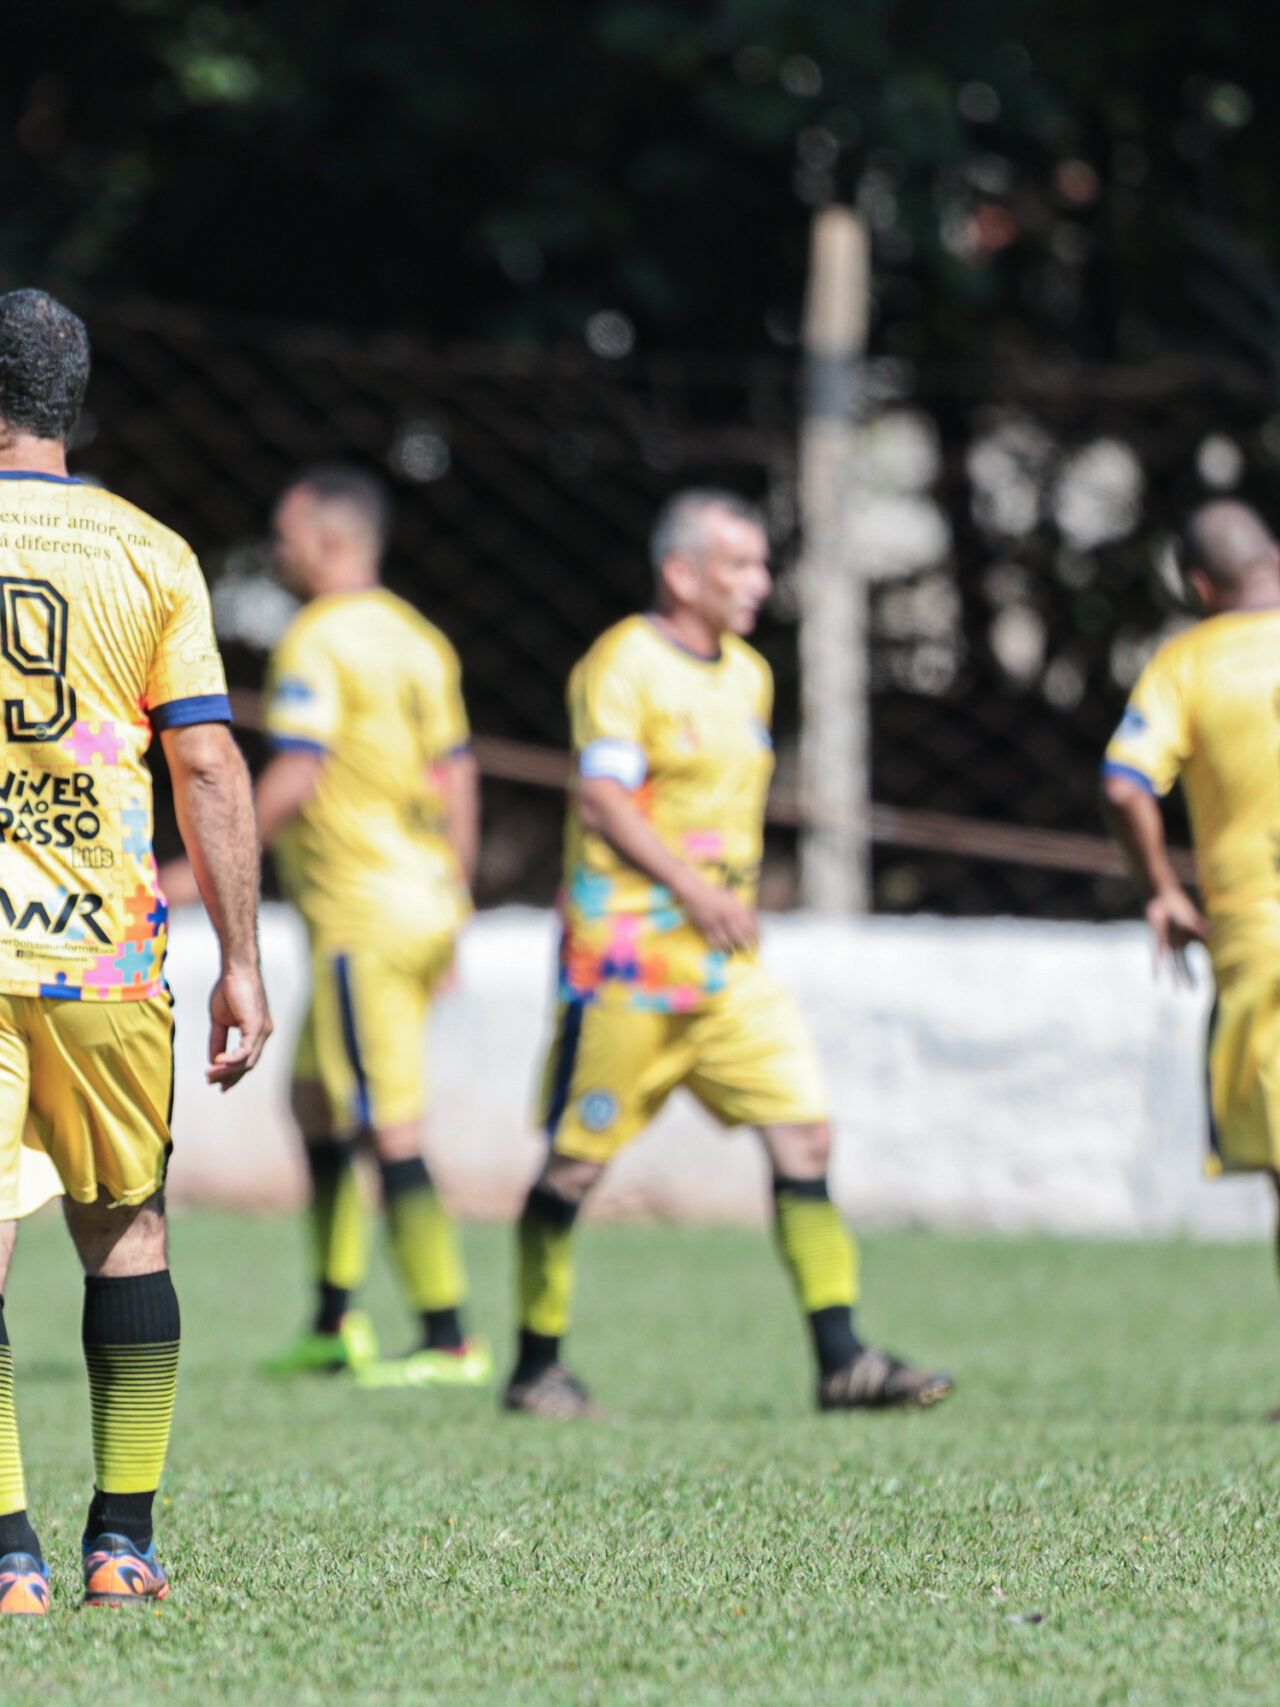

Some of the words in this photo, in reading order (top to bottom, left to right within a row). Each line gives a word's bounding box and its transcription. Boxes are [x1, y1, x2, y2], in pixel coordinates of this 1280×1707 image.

[0, 510, 61, 529] existir
[14, 534, 112, 560] diferenças
[19, 799, 50, 816] AO
